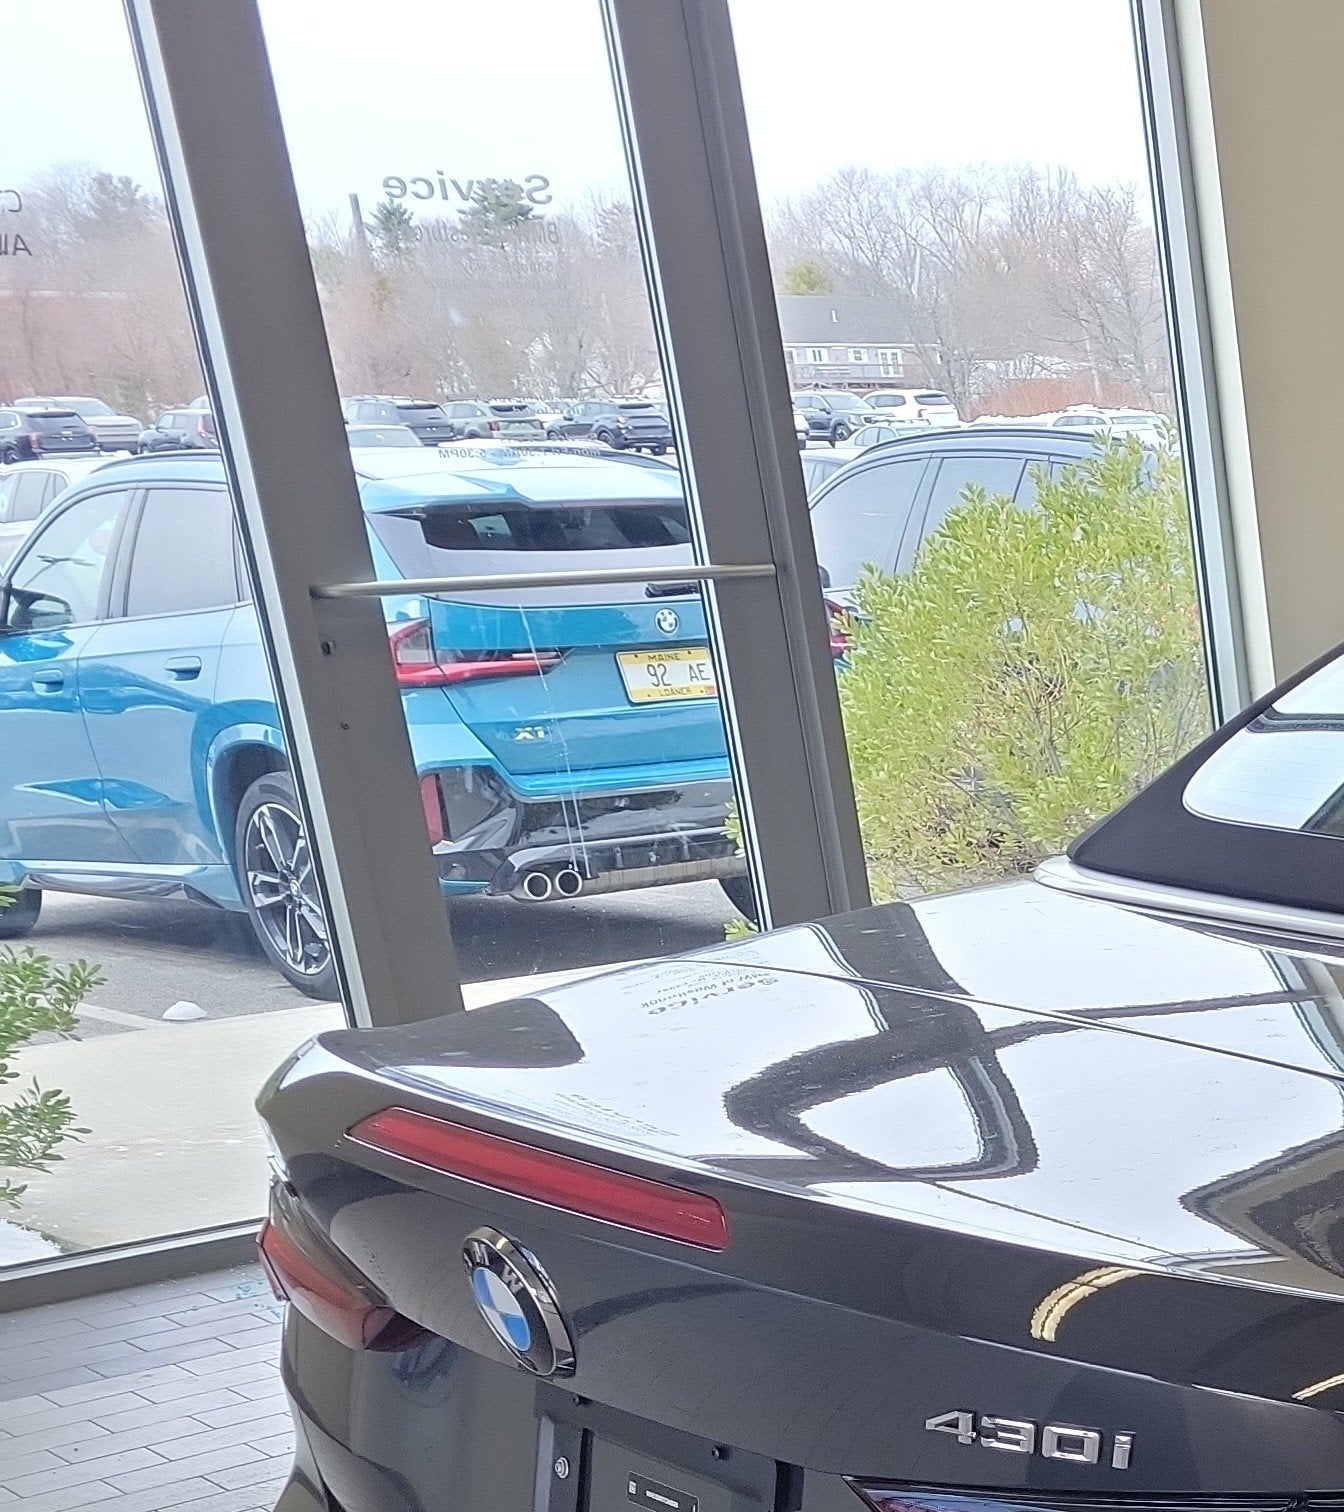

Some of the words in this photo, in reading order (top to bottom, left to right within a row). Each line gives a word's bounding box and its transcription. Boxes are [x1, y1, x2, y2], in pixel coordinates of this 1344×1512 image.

[647, 652, 681, 662] MAINE
[646, 663, 671, 688] 92
[688, 663, 711, 682] AE
[514, 726, 546, 742] X1
[925, 1409, 1137, 1470] 430i
